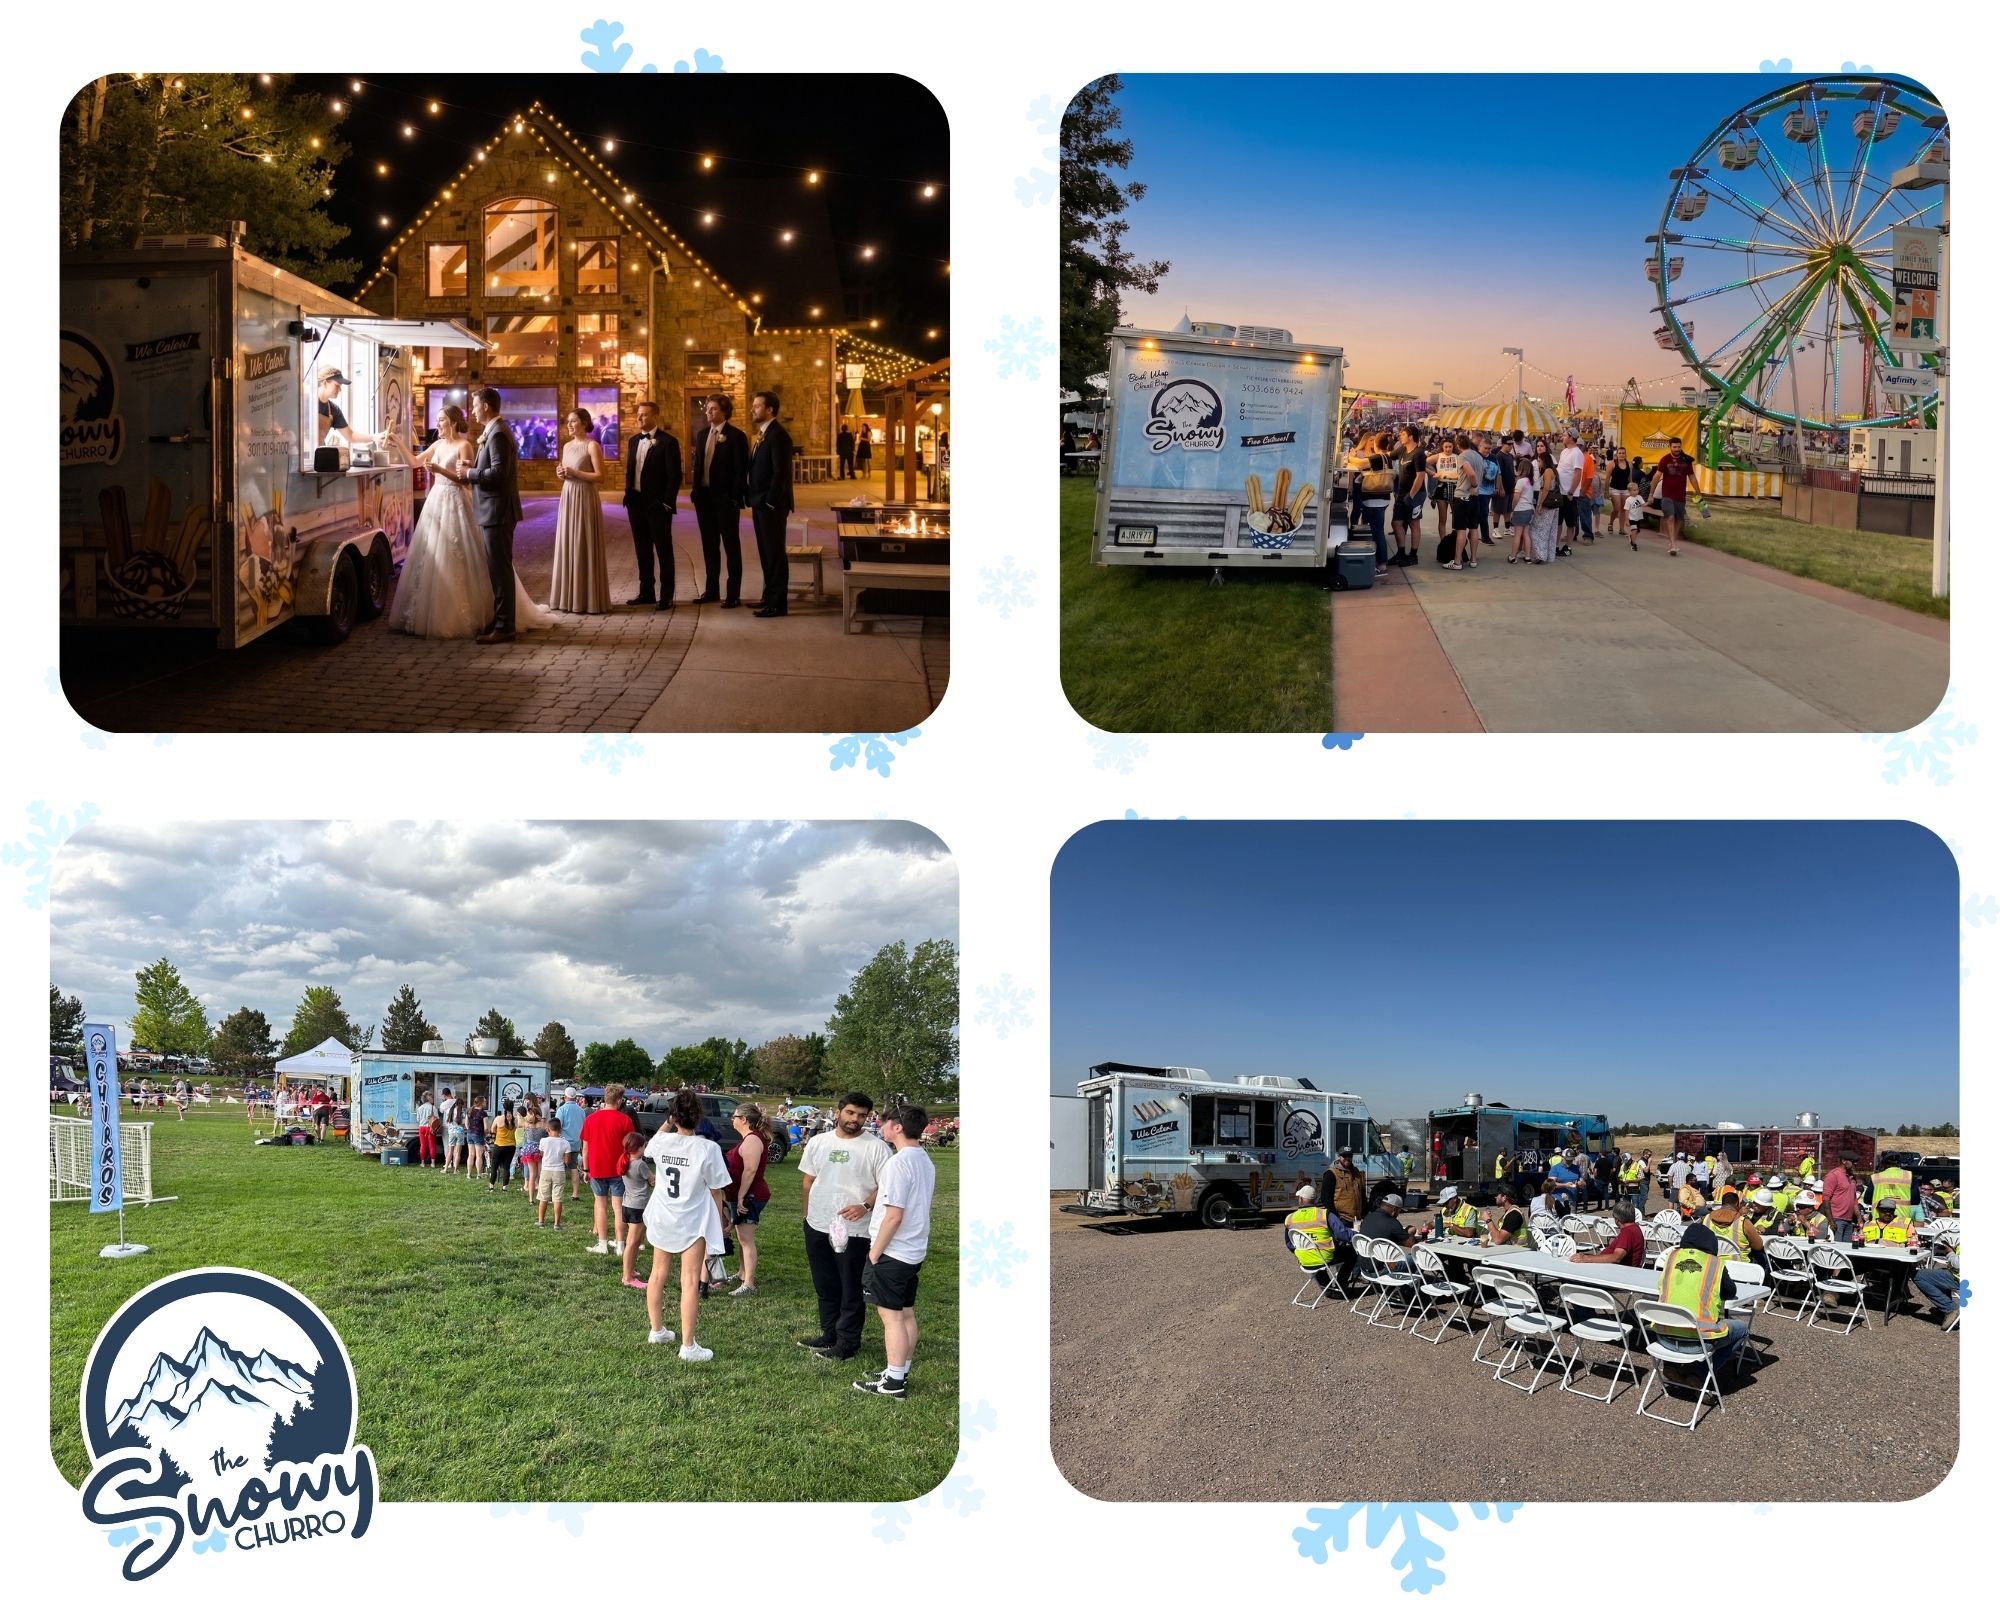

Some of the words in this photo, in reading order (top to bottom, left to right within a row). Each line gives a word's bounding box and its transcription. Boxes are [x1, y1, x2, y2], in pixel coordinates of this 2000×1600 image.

[1895, 270, 1936, 287] WELCOME!
[1886, 375, 1918, 386] Agfinity
[1145, 419, 1224, 450] Snowy
[1184, 440, 1214, 448] CHURRO
[1136, 1129, 1150, 1139] We
[1150, 1121, 1174, 1135] Cater!
[1282, 1136, 1325, 1158] Snowy
[666, 1166, 681, 1199] 3
